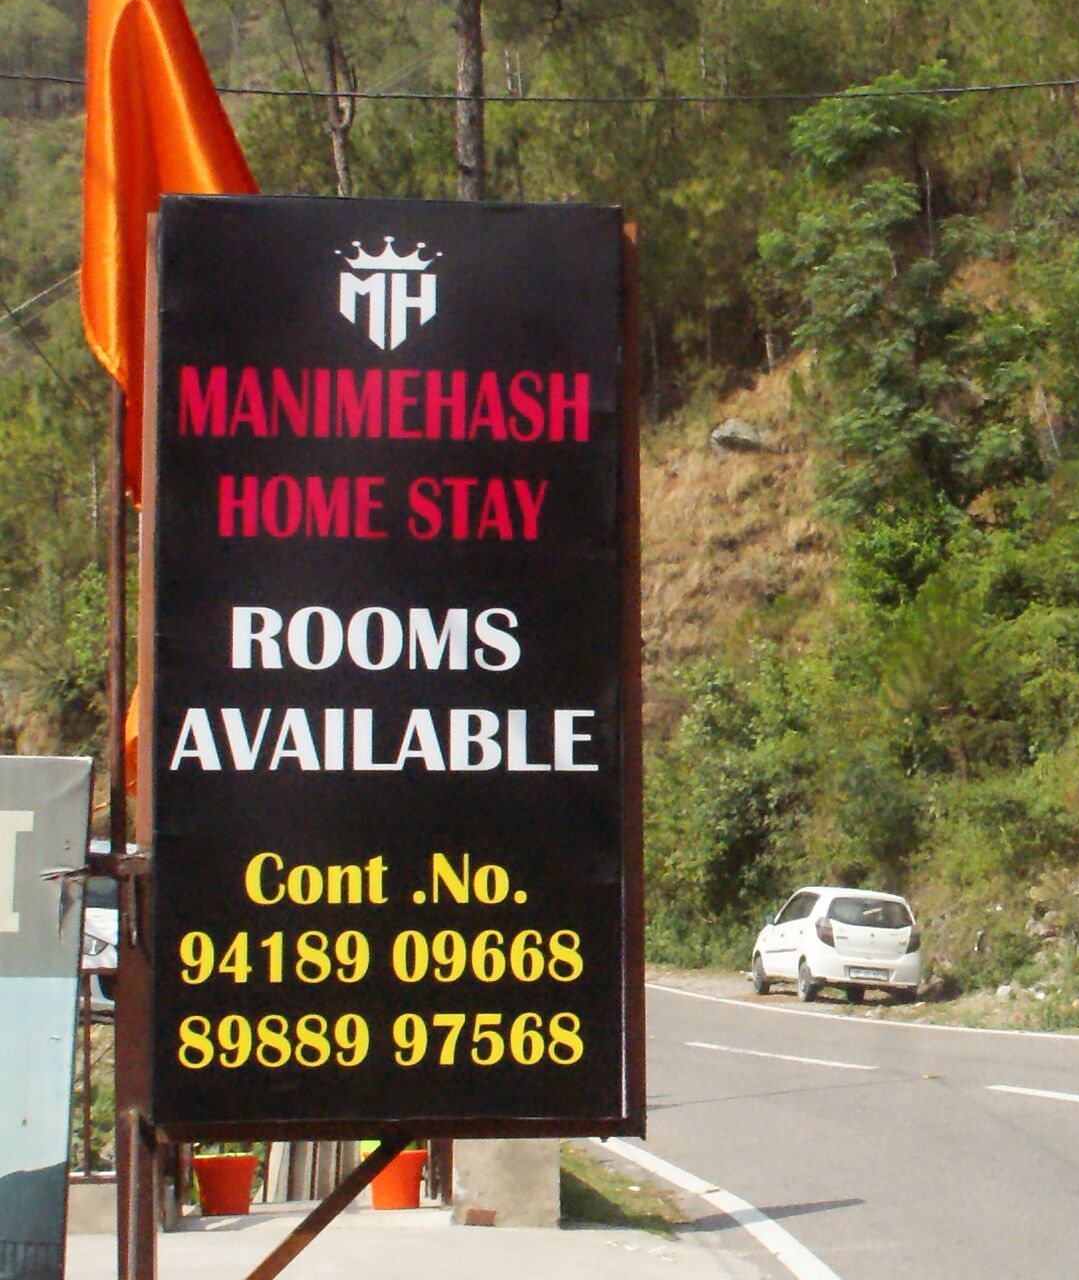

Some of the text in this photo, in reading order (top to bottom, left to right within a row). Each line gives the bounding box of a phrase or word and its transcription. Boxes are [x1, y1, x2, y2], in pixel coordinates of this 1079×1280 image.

[338, 271, 436, 351] MH
[180, 366, 592, 442] MANIMEHASH
[219, 474, 547, 541] HOME STAY
[230, 606, 522, 672] ROOMS
[169, 708, 600, 772] AVAILABLE
[244, 852, 389, 906] Cont
[178, 930, 584, 985] 94189 09668
[177, 1012, 584, 1069] 89889 97568
